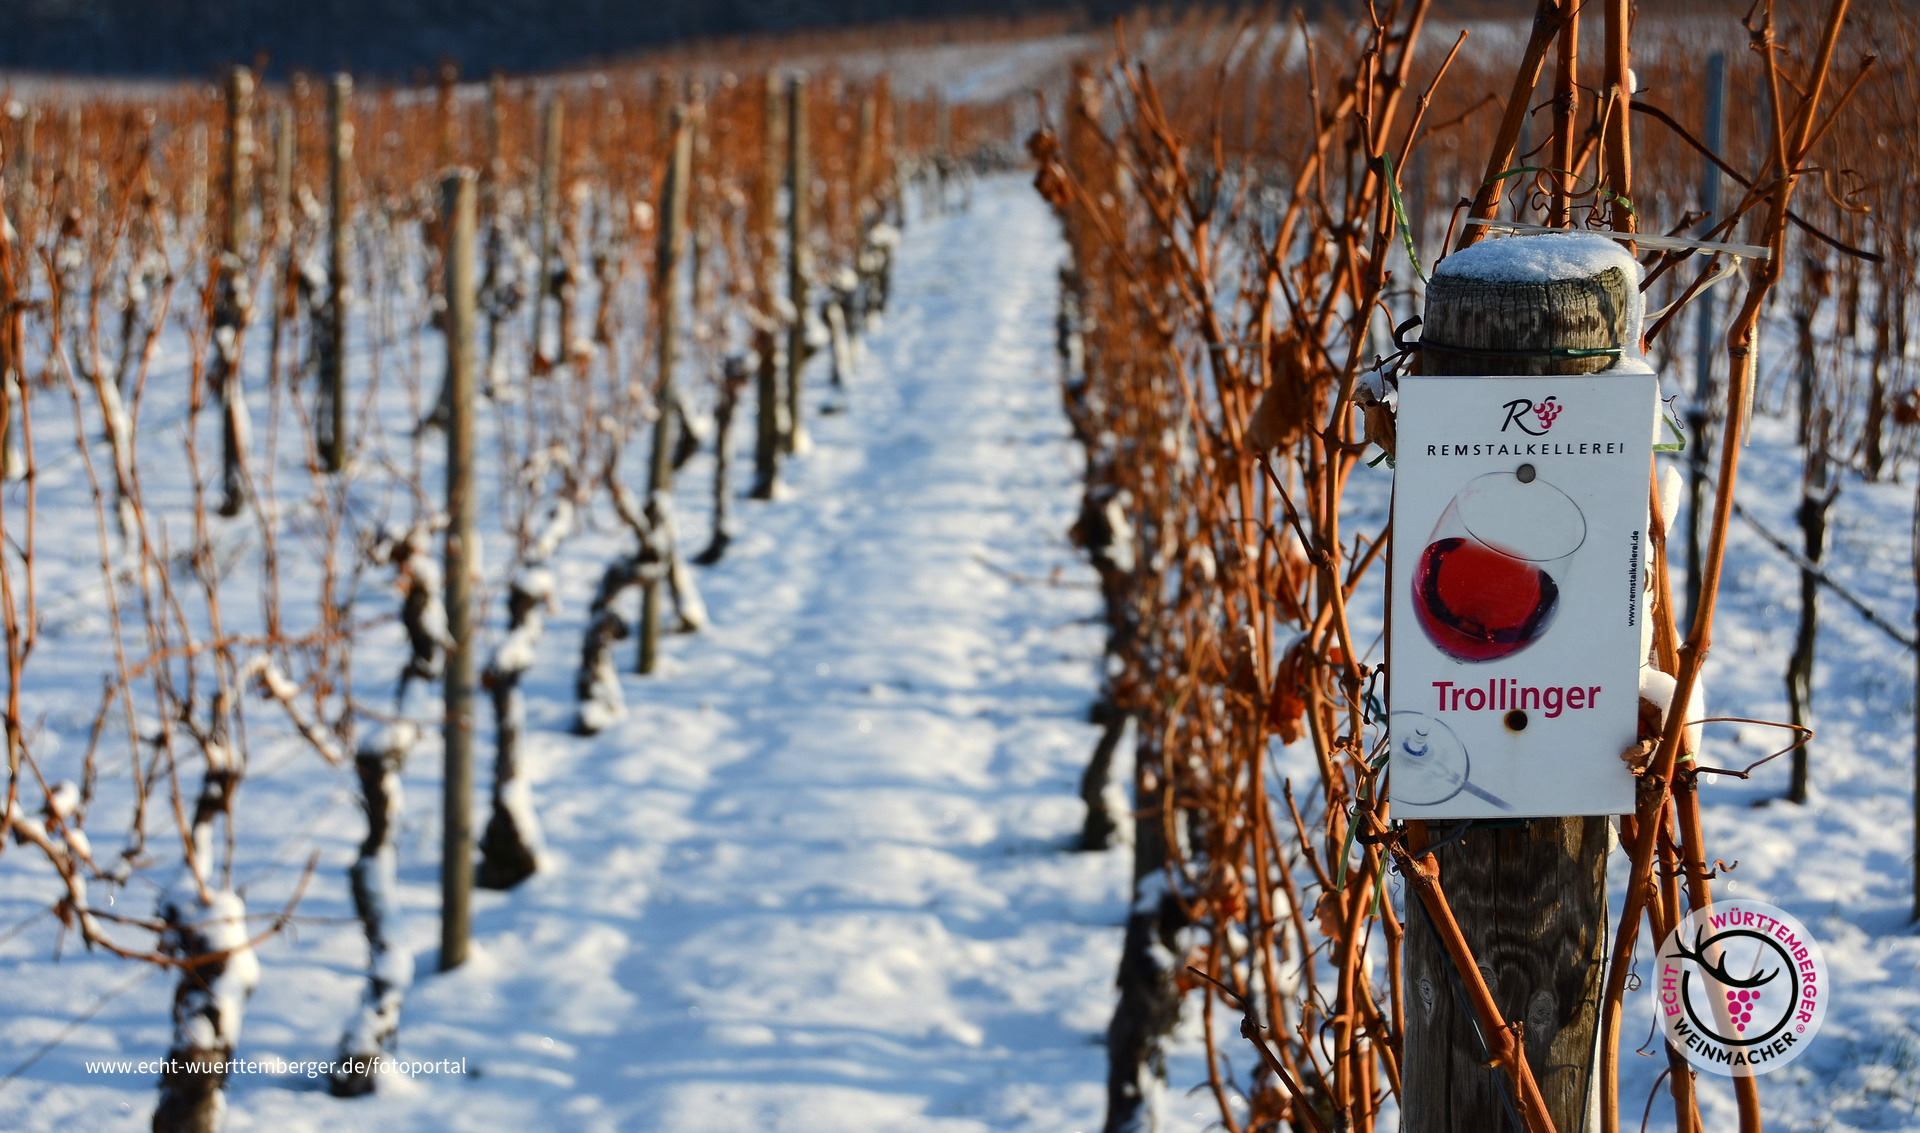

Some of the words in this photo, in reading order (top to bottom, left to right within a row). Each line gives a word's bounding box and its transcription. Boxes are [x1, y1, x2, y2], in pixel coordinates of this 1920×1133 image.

[1427, 442, 1625, 457] REMSTALKELLEREI
[1628, 530, 1640, 627] www.remstalkellerei.de
[1431, 678, 1602, 718] Trollinger
